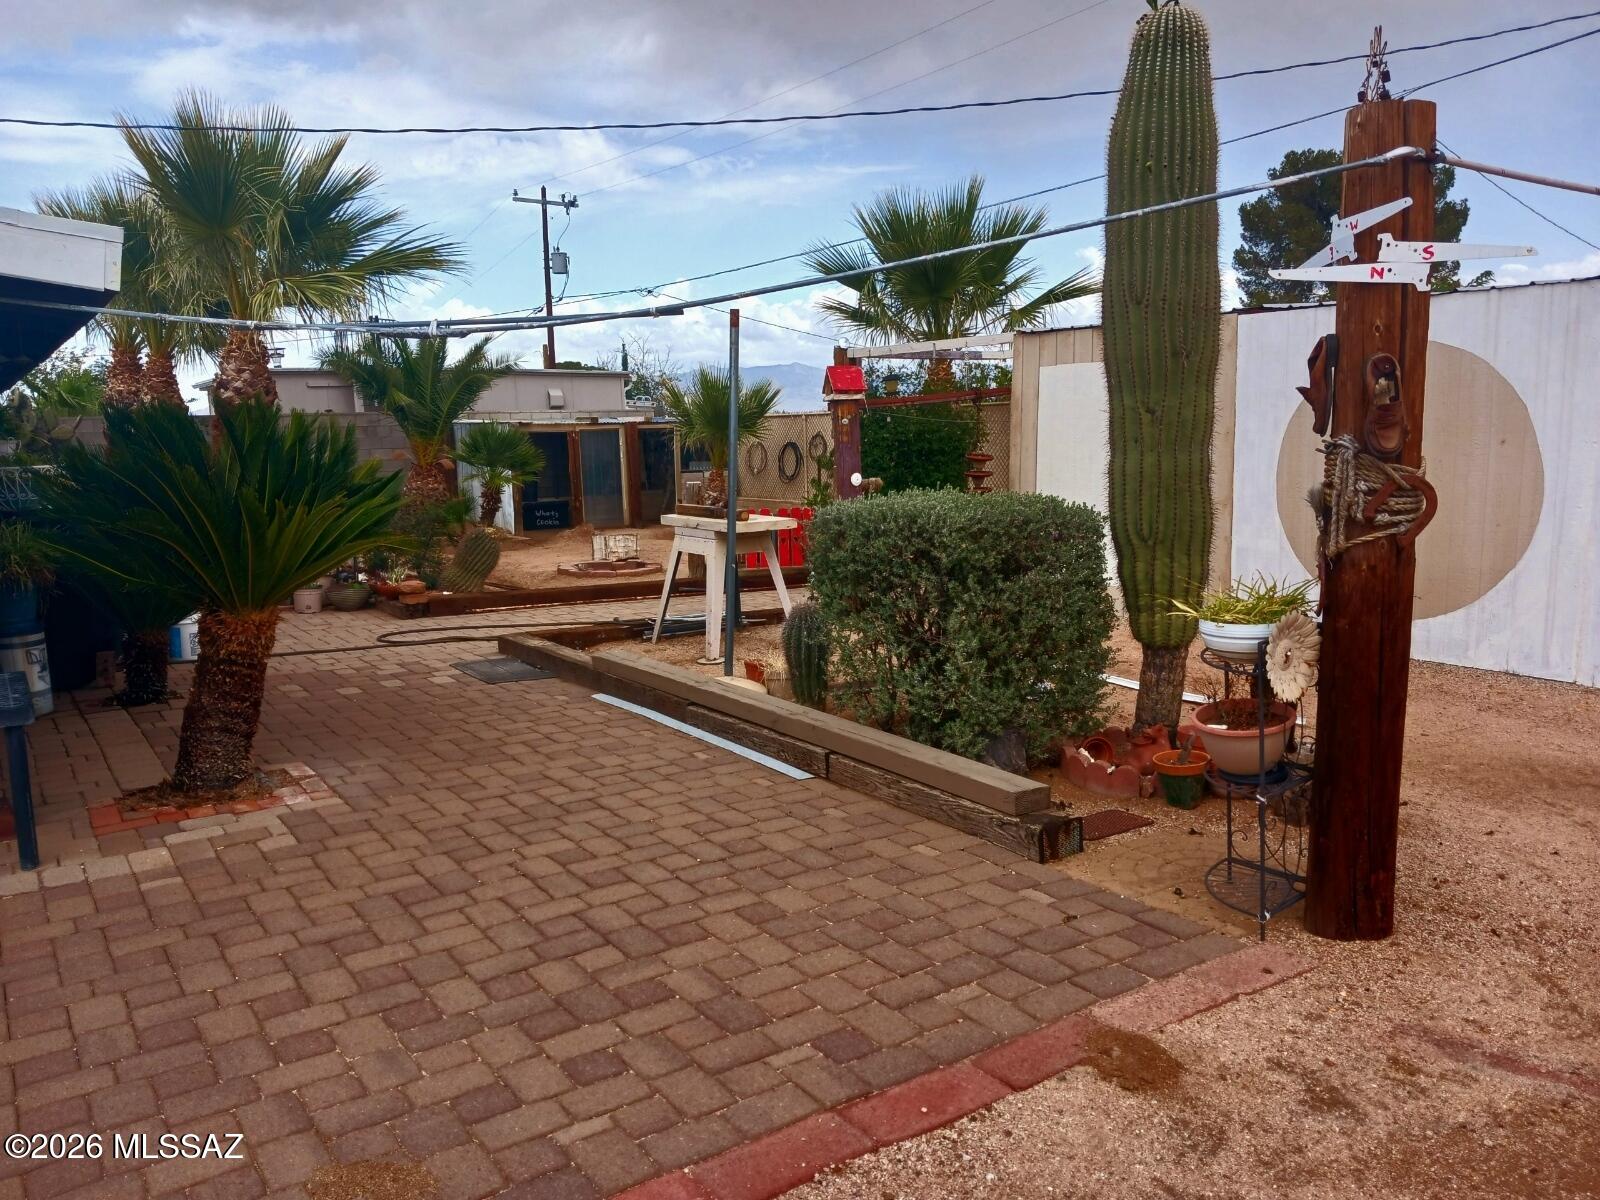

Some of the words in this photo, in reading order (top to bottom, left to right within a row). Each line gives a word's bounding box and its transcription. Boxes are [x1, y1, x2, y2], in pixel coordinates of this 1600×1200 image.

[1349, 219, 1359, 232] W
[1421, 245, 1435, 261] S
[1369, 266, 1385, 280] N
